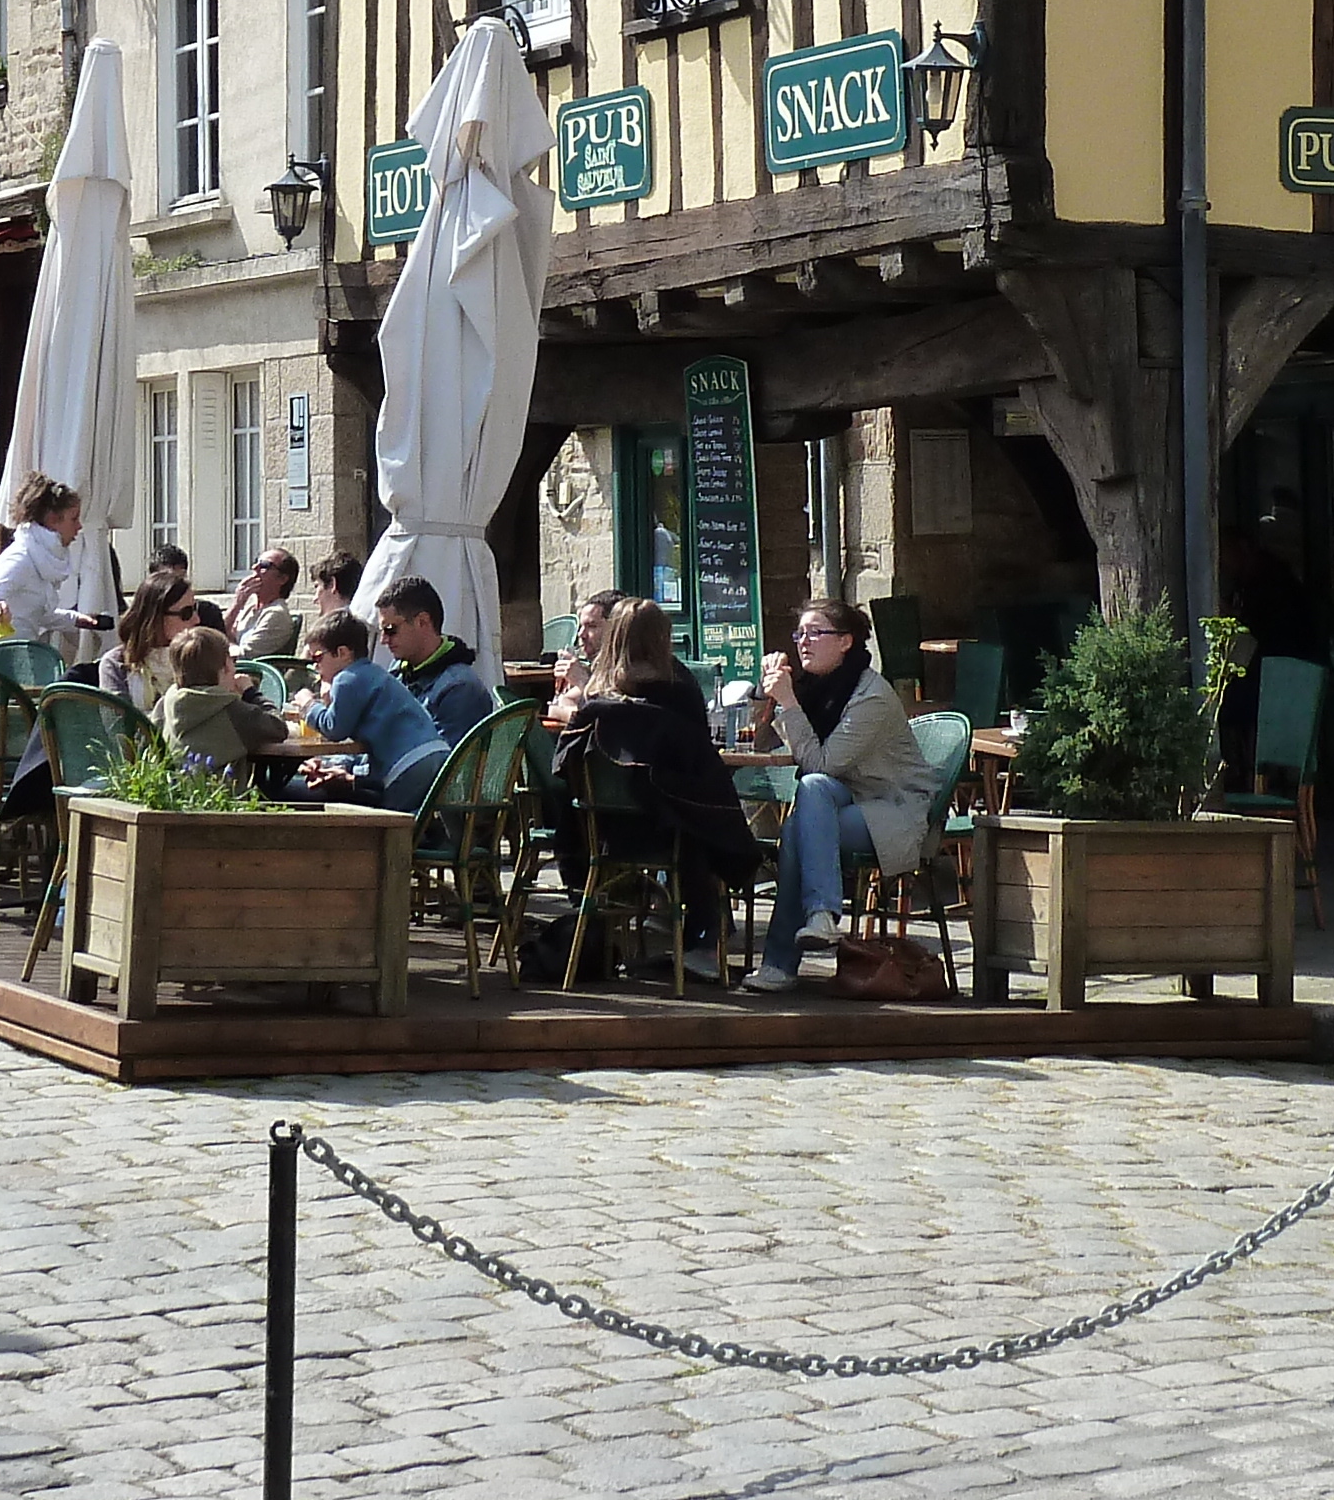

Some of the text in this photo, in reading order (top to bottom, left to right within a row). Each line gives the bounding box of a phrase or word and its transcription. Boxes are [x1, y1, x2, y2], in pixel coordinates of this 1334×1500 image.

[777, 66, 891, 142] SNACK
[564, 104, 642, 164] PUB
[374, 163, 430, 218] HOT
[690, 370, 740, 395] SNACK
